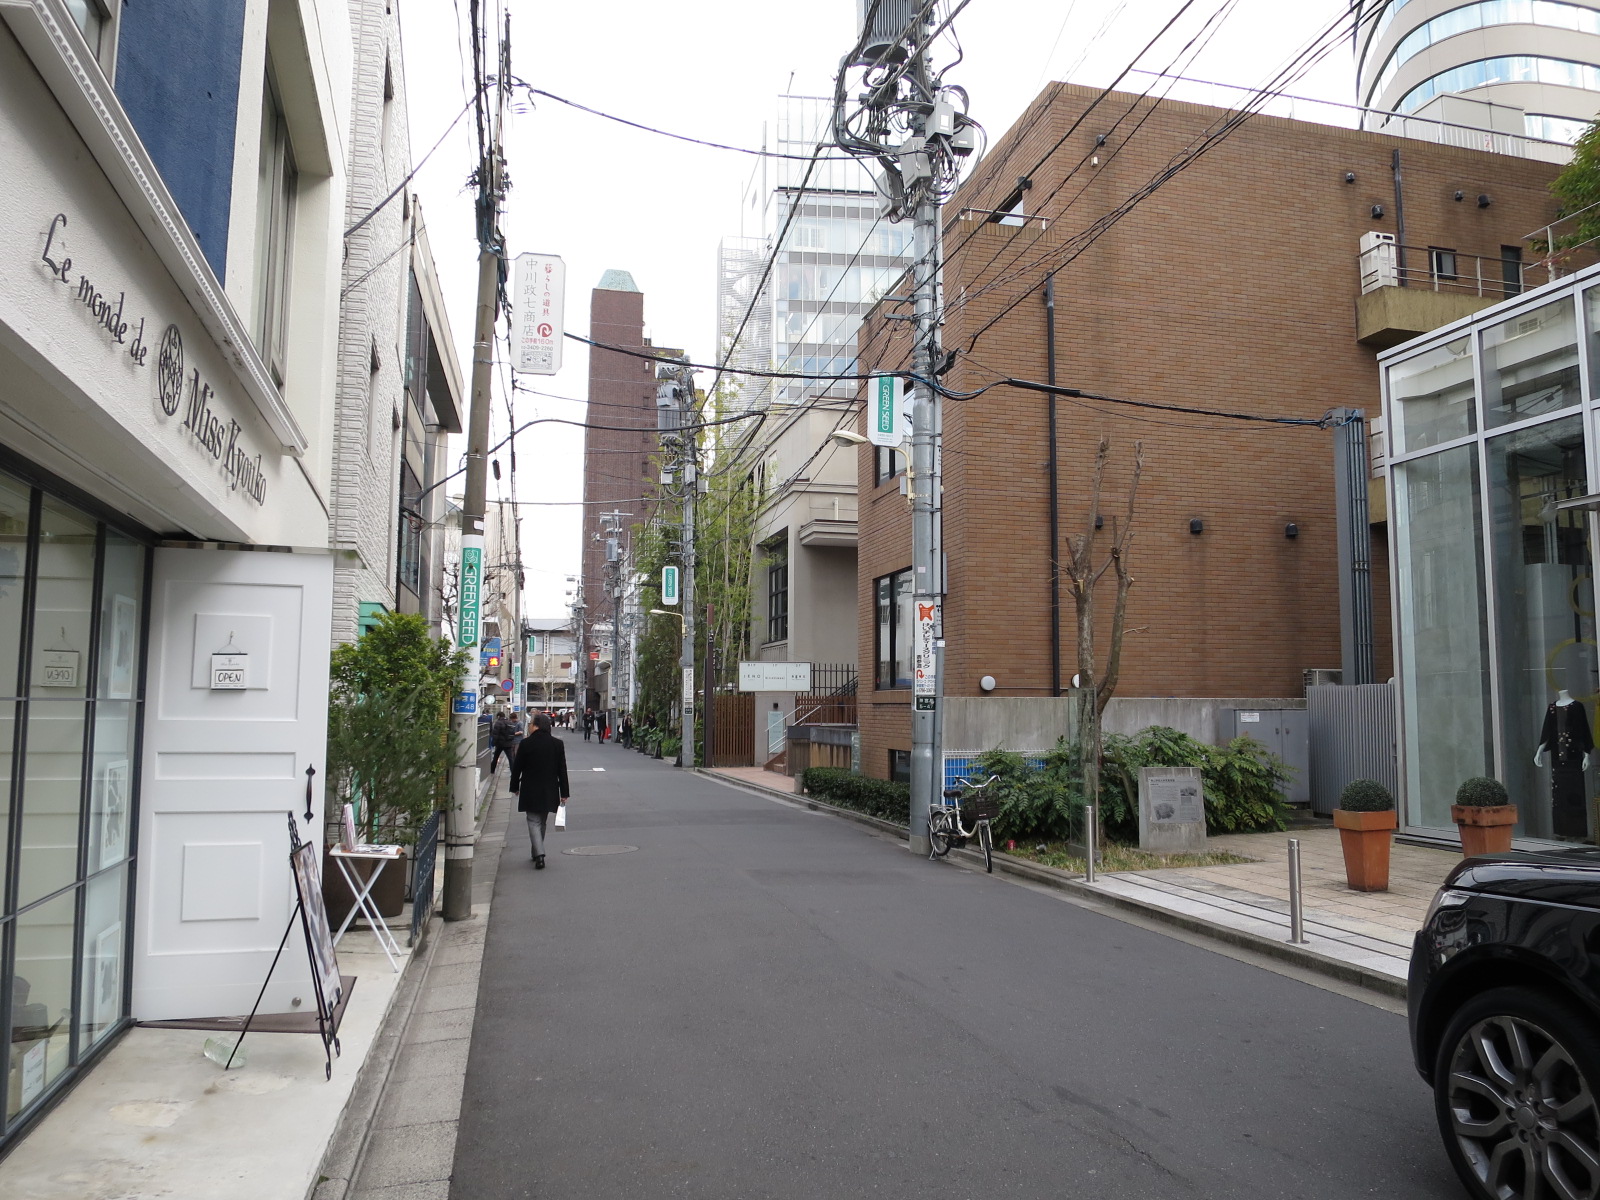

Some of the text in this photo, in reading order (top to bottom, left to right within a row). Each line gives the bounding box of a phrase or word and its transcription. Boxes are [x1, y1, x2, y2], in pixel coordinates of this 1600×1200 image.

[42, 213, 148, 367] Le monde de
[522, 258, 538, 337] 中川政七商店
[182, 367, 267, 507] Miss Kyouko
[881, 411, 890, 431] SEED
[882, 384, 890, 411] GREEN
[461, 566, 477, 645] GREEN SEED
[217, 672, 241, 682] OPEN
